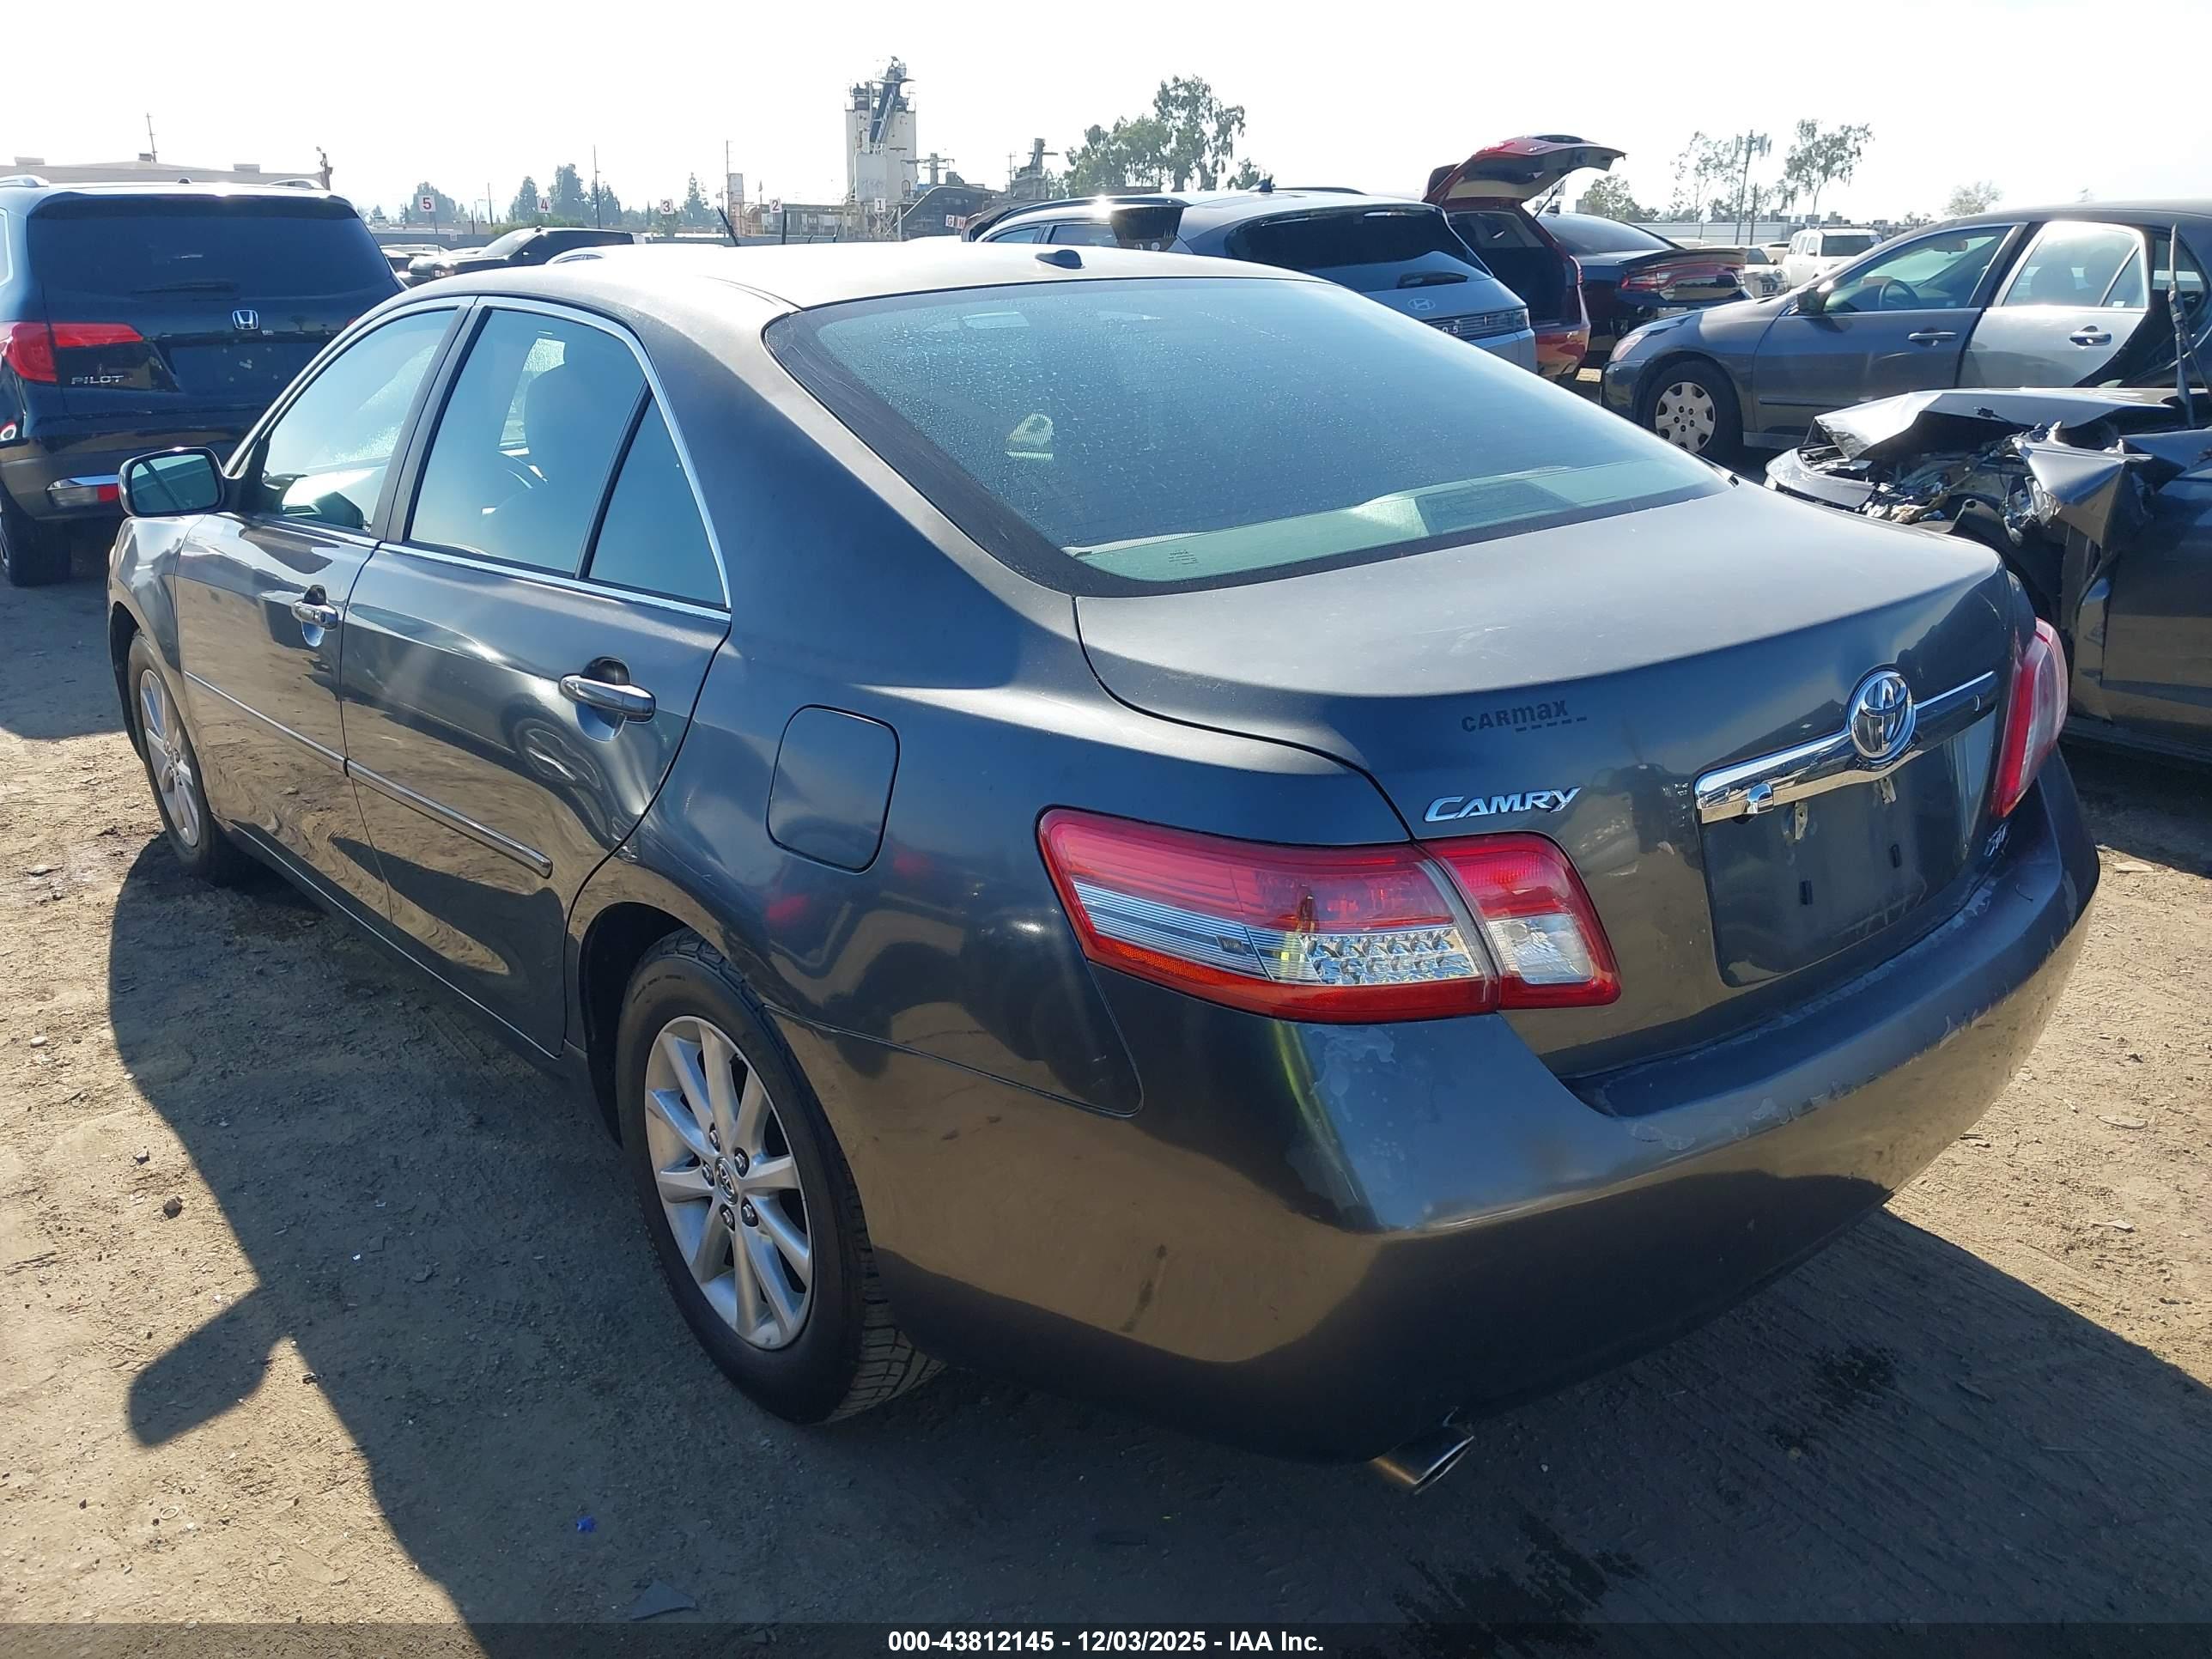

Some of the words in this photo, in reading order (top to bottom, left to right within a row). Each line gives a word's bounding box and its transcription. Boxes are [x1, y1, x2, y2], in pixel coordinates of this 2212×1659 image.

[422, 198, 431, 210] 5
[540, 198, 549, 211] 4
[663, 200, 671, 212] 3
[772, 200, 779, 211] 2
[877, 200, 884, 211] 1
[71, 375, 125, 385] PILOT
[1425, 787, 1582, 822] CAMRY
